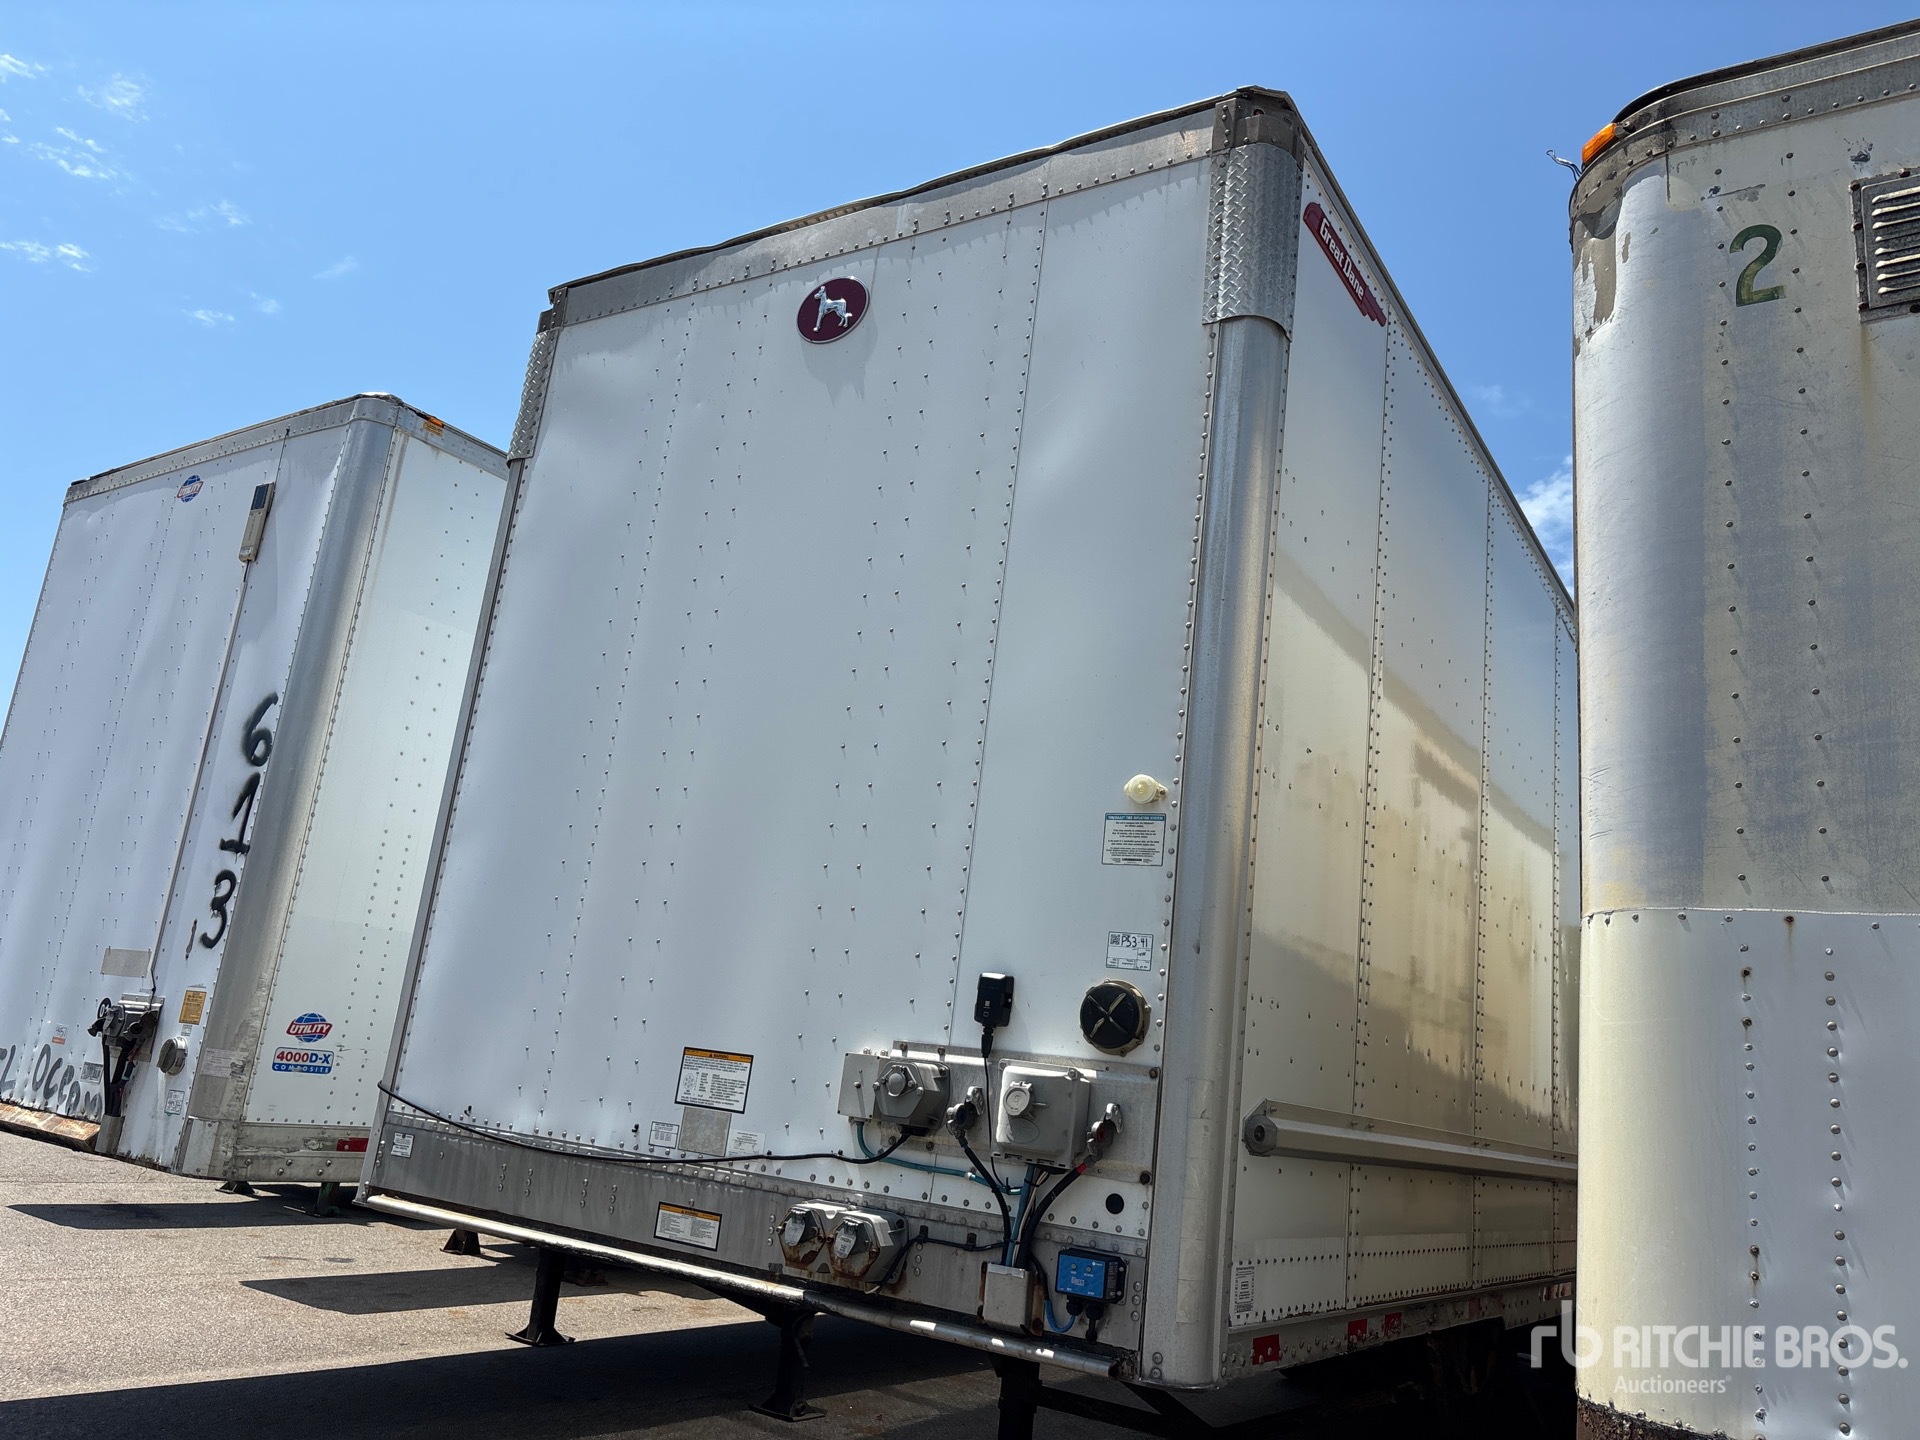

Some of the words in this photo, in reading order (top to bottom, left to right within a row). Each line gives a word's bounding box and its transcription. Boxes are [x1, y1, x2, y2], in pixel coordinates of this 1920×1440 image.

[1320, 218, 1344, 267] Great
[1343, 256, 1364, 300] Dane
[1729, 224, 1785, 307] 2
[289, 1023, 331, 1035] UTILITY
[276, 1051, 331, 1065] 4000D-X
